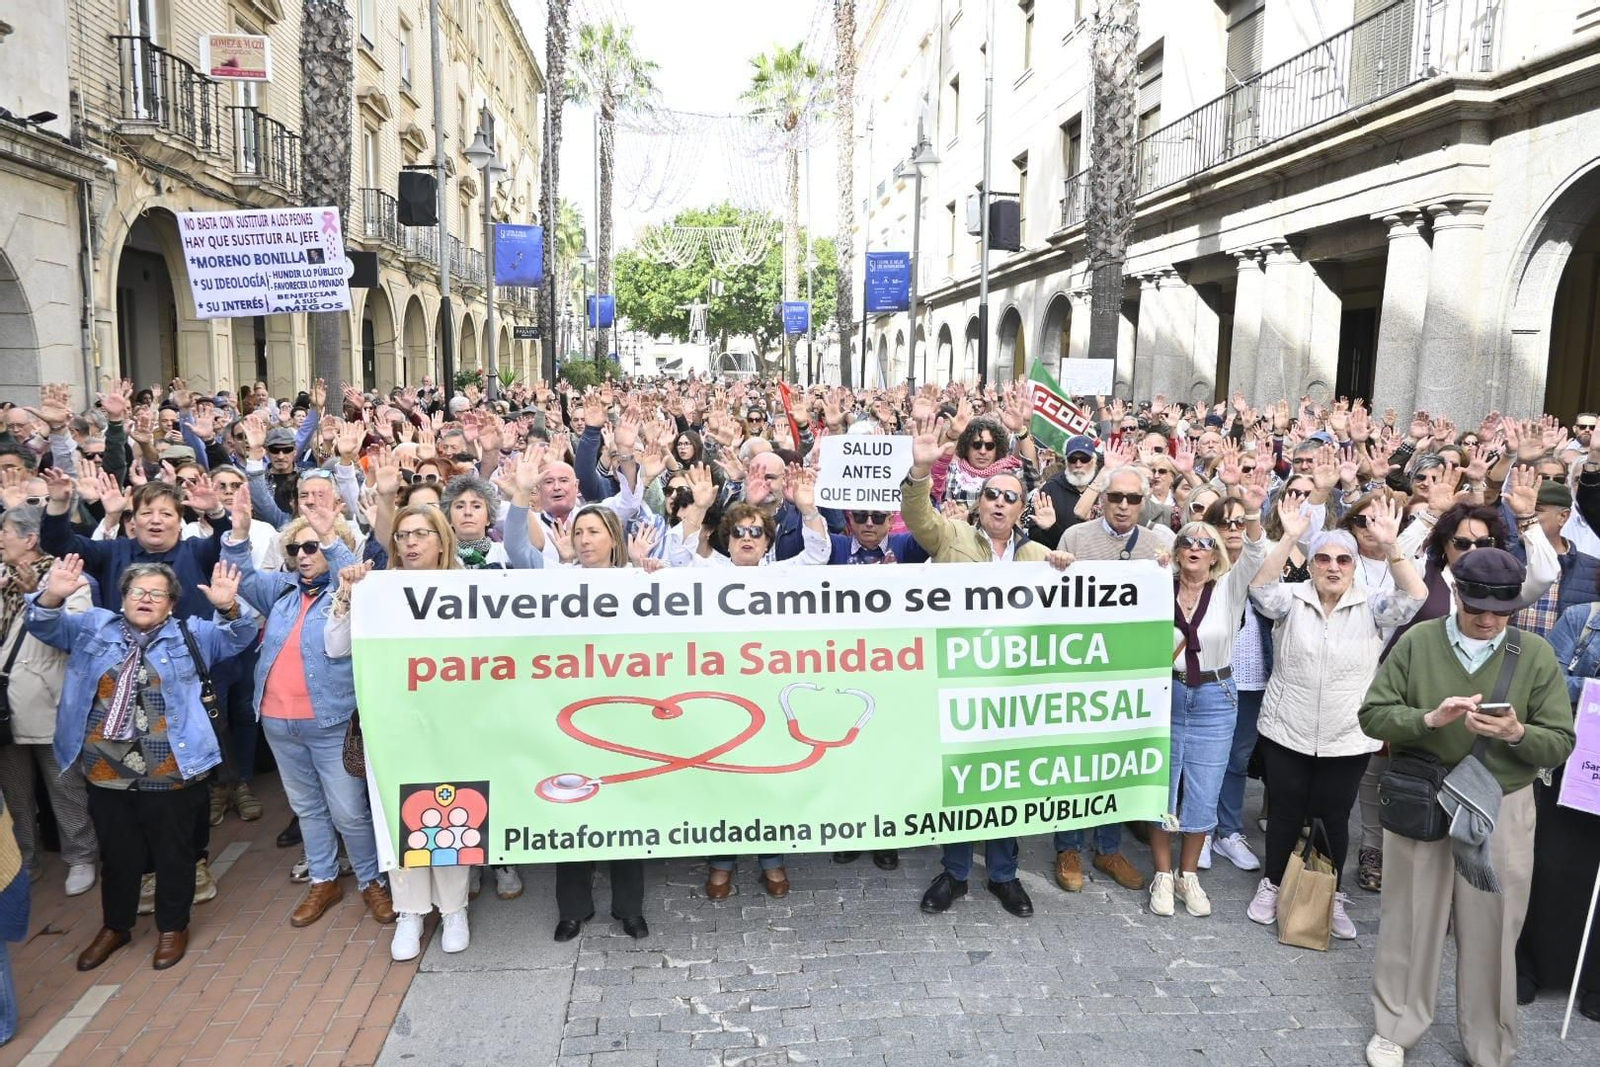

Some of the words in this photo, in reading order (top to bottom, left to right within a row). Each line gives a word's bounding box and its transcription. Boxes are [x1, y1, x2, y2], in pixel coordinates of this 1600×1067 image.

[184, 217, 195, 231] NO
[197, 217, 218, 230] BASTA
[220, 215, 234, 229] CON
[236, 214, 269, 228] SUSTITUIR
[271, 214, 276, 226] A
[276, 213, 289, 226] LOS
[289, 212, 313, 226] PEONES
[185, 236, 205, 248] HAY
[208, 235, 230, 249] QUE
[231, 232, 284, 246] SUSTITUIR
[286, 231, 298, 243] AL
[300, 231, 319, 246] JEFE
[253, 251, 307, 266] BONILLA
[201, 278, 213, 291] SU
[214, 272, 267, 290] IDEOLOGÍA
[272, 269, 301, 279] HUNDIR
[302, 268, 312, 278] LO
[314, 266, 344, 277] PÚBLICO
[274, 280, 308, 291] FAVORECER
[309, 280, 317, 289] LO
[318, 278, 345, 288] PRIVADO
[206, 301, 220, 312] SU
[221, 296, 264, 312] INTERÉS
[277, 291, 338, 300] BENEFICIAR
[273, 302, 344, 313] AMIGOS
[1034, 390, 1090, 433] CCOO
[843, 442, 893, 456] SALUD
[842, 465, 892, 479] ANTES
[820, 487, 852, 502] QUE
[856, 488, 902, 502] DINER
[403, 583, 619, 620] Valverde
[633, 582, 703, 617] del
[718, 580, 892, 616] Camino
[904, 586, 952, 613] se
[965, 575, 1138, 610] moviliza
[946, 629, 1110, 670] PÚBLICA
[407, 653, 517, 692] para
[531, 643, 673, 679] salvar
[687, 641, 725, 677] la
[739, 637, 925, 675] Sanidad
[949, 688, 1152, 731] UNIVERSAL
[949, 765, 973, 794] Y
[980, 761, 1021, 792] DE
[1029, 747, 1164, 787] CALIDAD
[504, 823, 661, 852] Plataforma
[668, 818, 812, 846] ciudadana
[820, 819, 867, 846] por
[874, 813, 897, 838] la
[904, 804, 1018, 837] SANIDAD
[1024, 793, 1118, 825] PÚBLICA
